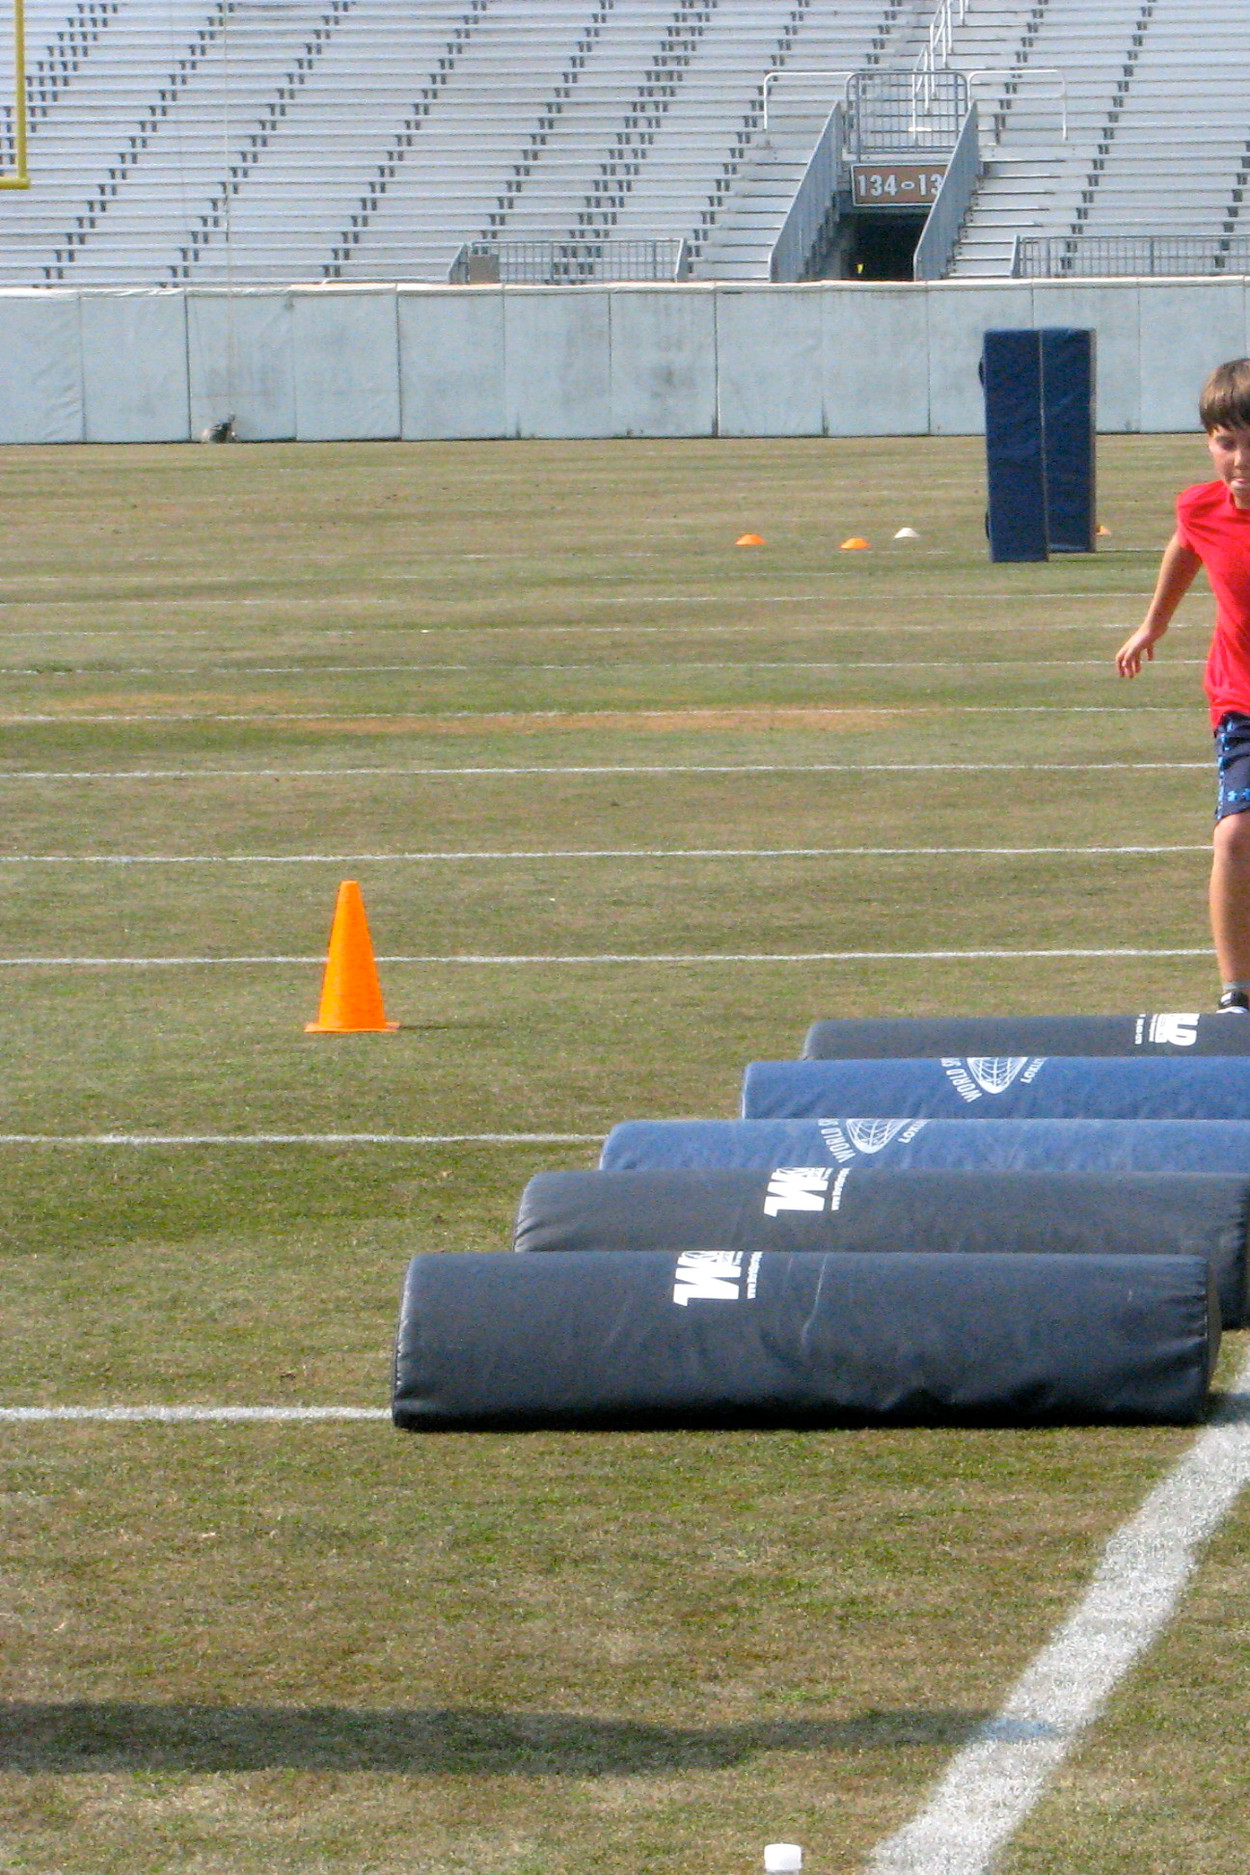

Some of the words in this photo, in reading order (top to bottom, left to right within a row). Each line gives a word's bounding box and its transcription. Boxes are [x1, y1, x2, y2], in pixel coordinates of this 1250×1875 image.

[858, 174, 943, 197] 134-13
[945, 1068, 982, 1103] WORLD
[820, 1127, 857, 1163] WORLD
